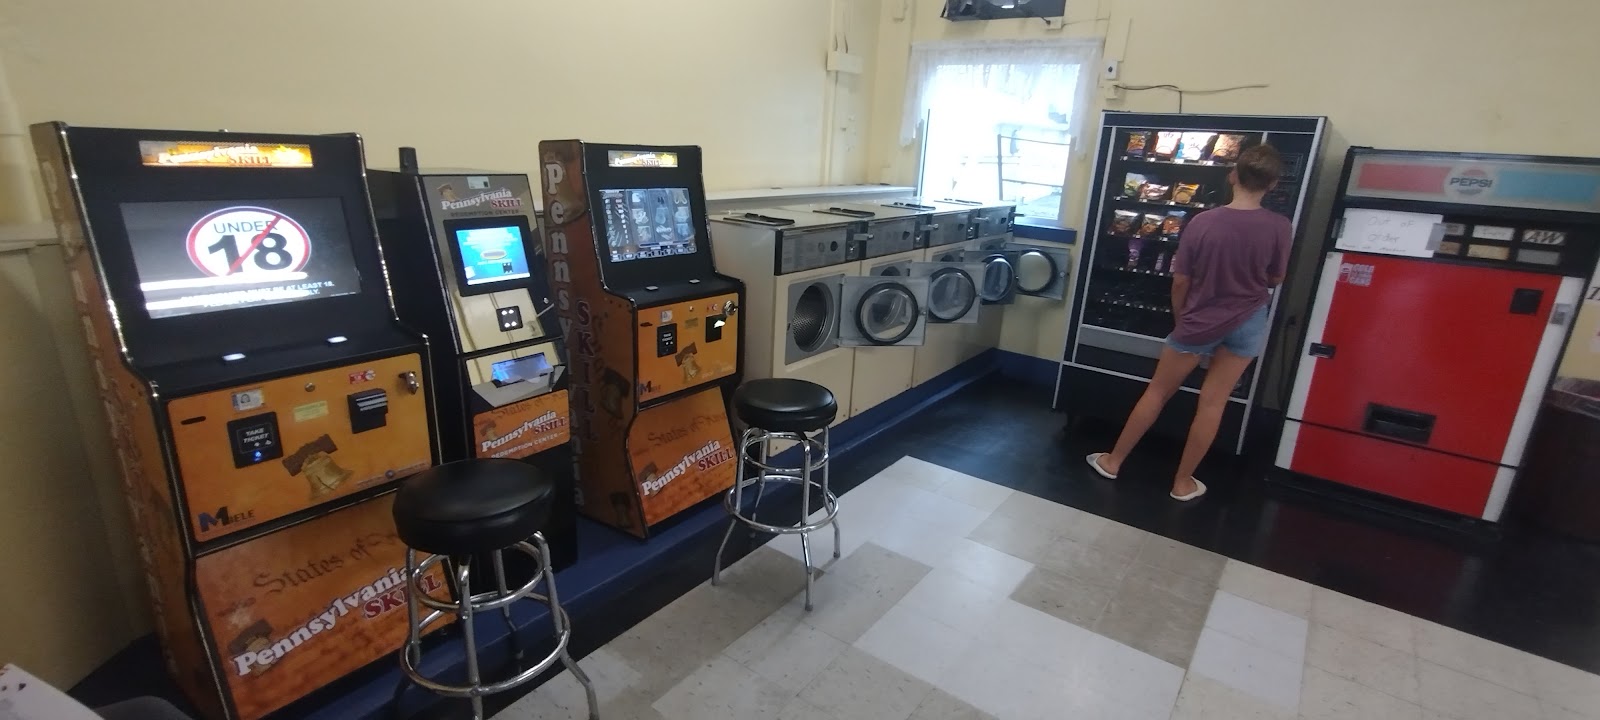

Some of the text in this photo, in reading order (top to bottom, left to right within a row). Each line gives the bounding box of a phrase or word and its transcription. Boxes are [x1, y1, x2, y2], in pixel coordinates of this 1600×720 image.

[1449, 177, 1494, 188] PEPSI
[440, 187, 513, 210] Pennsylvania
[490, 198, 523, 209] SKILL
[213, 219, 278, 234] UNDER
[207, 231, 293, 273] 18
[297, 281, 322, 290] LEAST
[245, 427, 265, 437] TAKE
[481, 410, 557, 453] Pennsylvania
[534, 416, 567, 435] SKILL
[242, 433, 270, 444] TICKET
[534, 432, 558, 445] CENTER
[641, 439, 722, 497] Pennsylvania
[697, 451, 735, 473] SKILL
[252, 553, 345, 594] States
[363, 573, 442, 619] SKL
